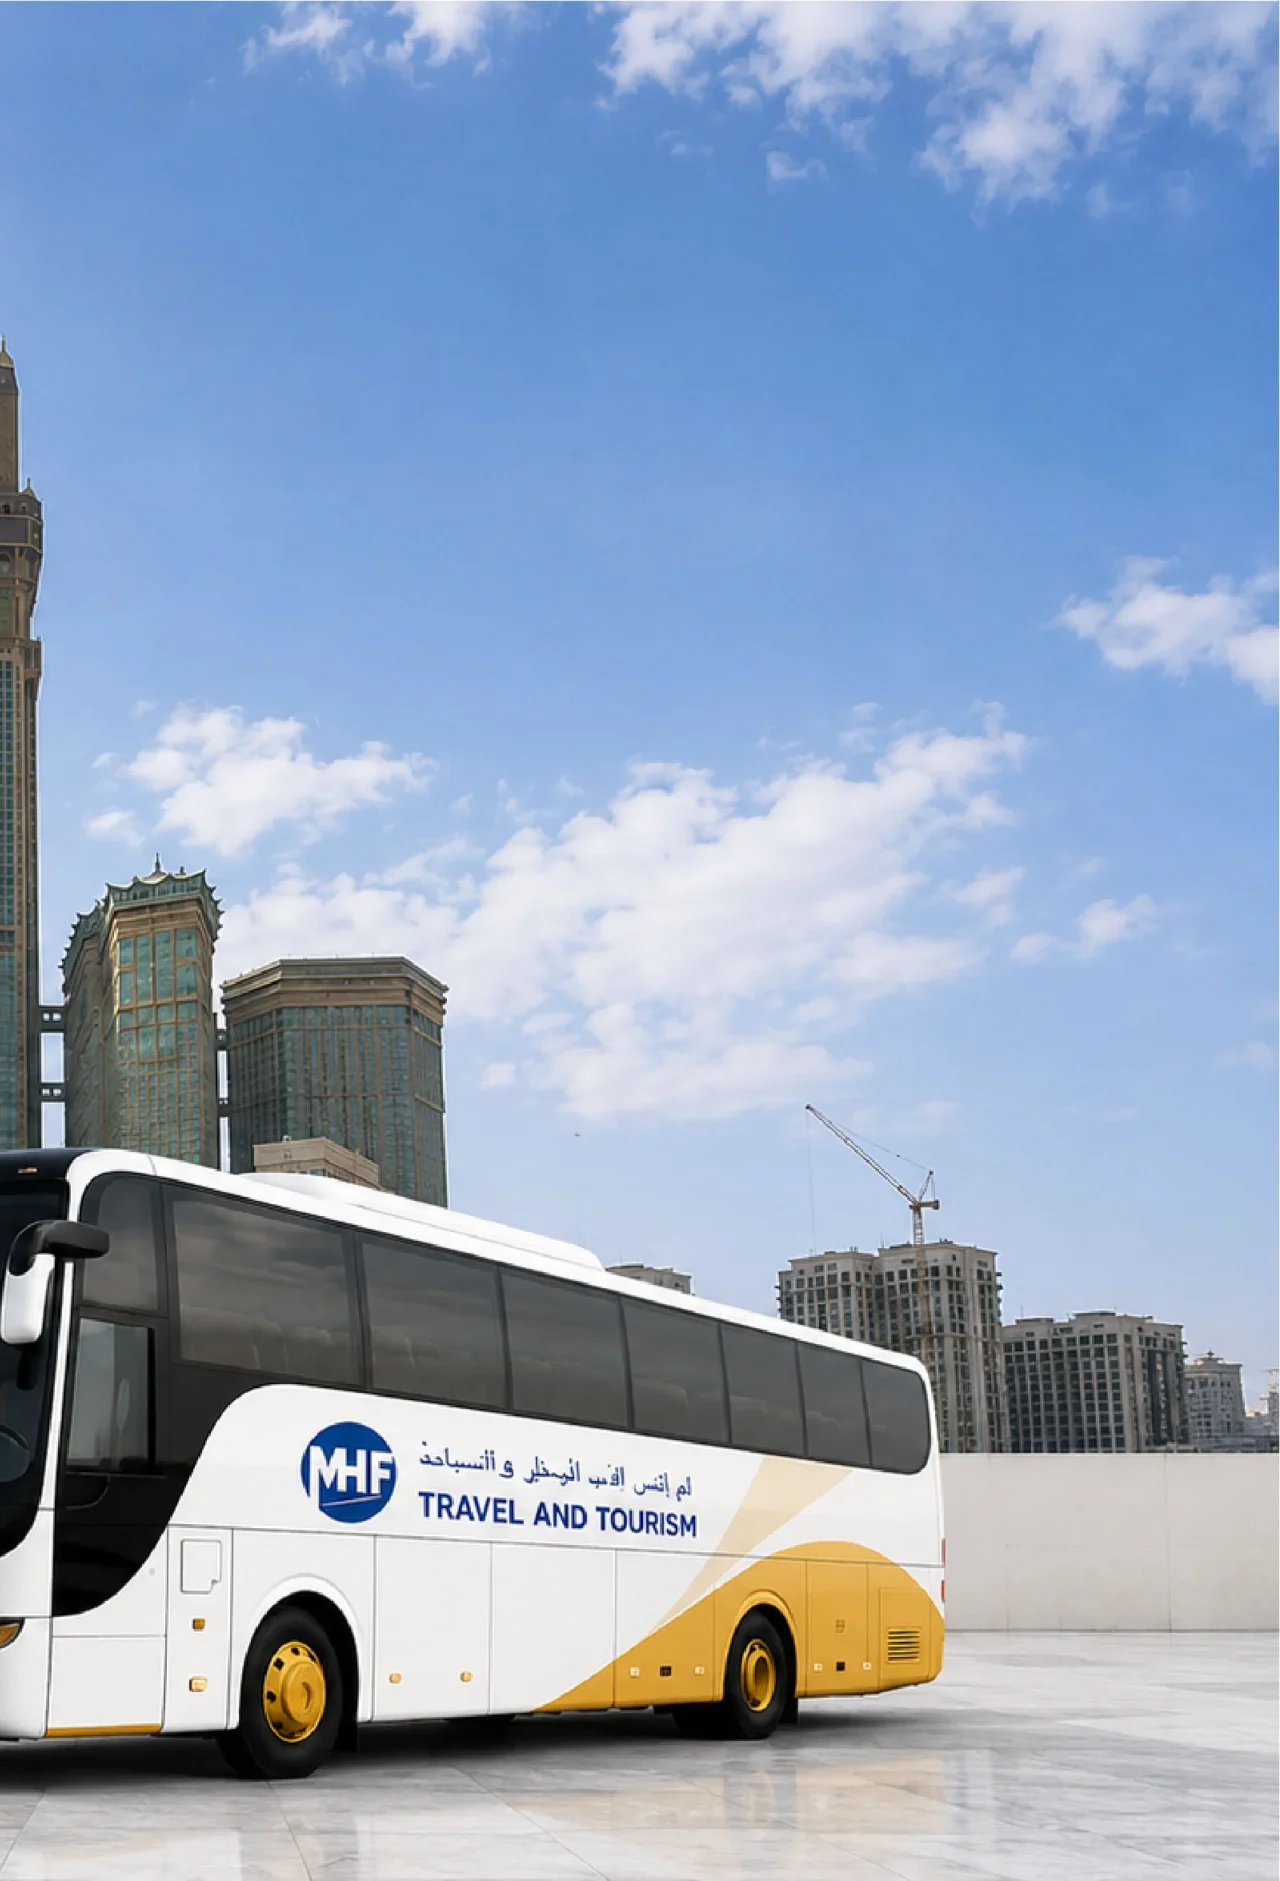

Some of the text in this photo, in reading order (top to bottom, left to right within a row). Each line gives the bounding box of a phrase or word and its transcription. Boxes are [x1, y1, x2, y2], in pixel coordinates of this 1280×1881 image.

[309, 1445, 393, 1508] MHF
[418, 1491, 697, 1537] TRAVEL AND TOURISM
